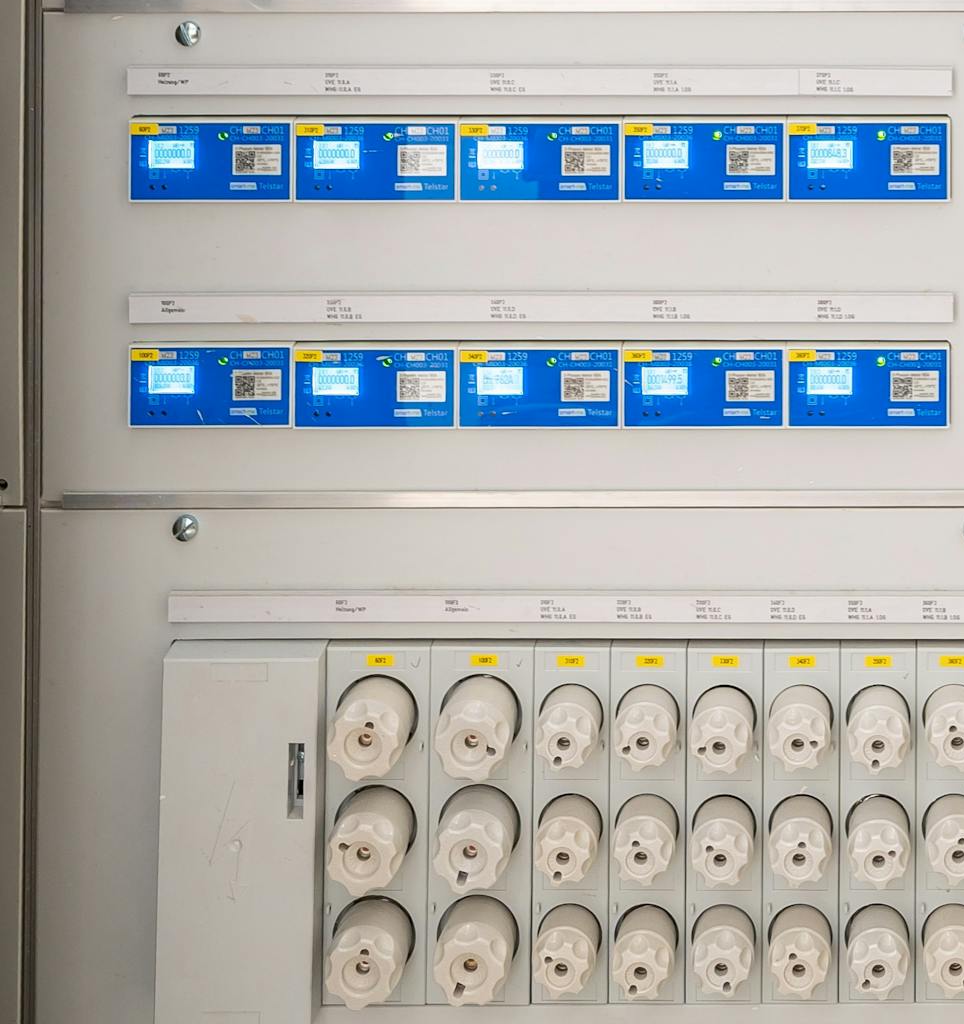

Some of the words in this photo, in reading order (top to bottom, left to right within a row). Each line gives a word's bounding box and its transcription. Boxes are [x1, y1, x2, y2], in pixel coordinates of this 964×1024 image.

[179, 126, 199, 135] 1259
[230, 126, 242, 135] CH
[262, 126, 284, 135] CH01
[344, 127, 364, 135] 1259
[394, 127, 406, 135] CH
[426, 127, 449, 135] CH01
[508, 127, 528, 136] 1259
[559, 127, 571, 136] CH
[590, 127, 613, 136] CH01
[673, 126, 693, 135] 1259
[724, 126, 736, 135] CH
[755, 126, 777, 135] CH01
[837, 126, 857, 135] 1259
[888, 126, 900, 135] CH
[919, 126, 942, 135] CH01
[179, 351, 199, 360] 1259
[230, 351, 242, 360] CH
[262, 351, 284, 360] CH01
[344, 352, 364, 361] 1259
[394, 352, 406, 361] CH
[426, 352, 448, 361] CH01
[508, 352, 528, 361] 1259
[558, 352, 570, 361] CH
[590, 352, 612, 361] CH01
[672, 352, 692, 360] 1259
[723, 352, 735, 360] CH
[754, 352, 777, 360] CH01
[837, 352, 857, 360] 1259
[887, 352, 900, 360] CH
[919, 352, 942, 360] CH01
